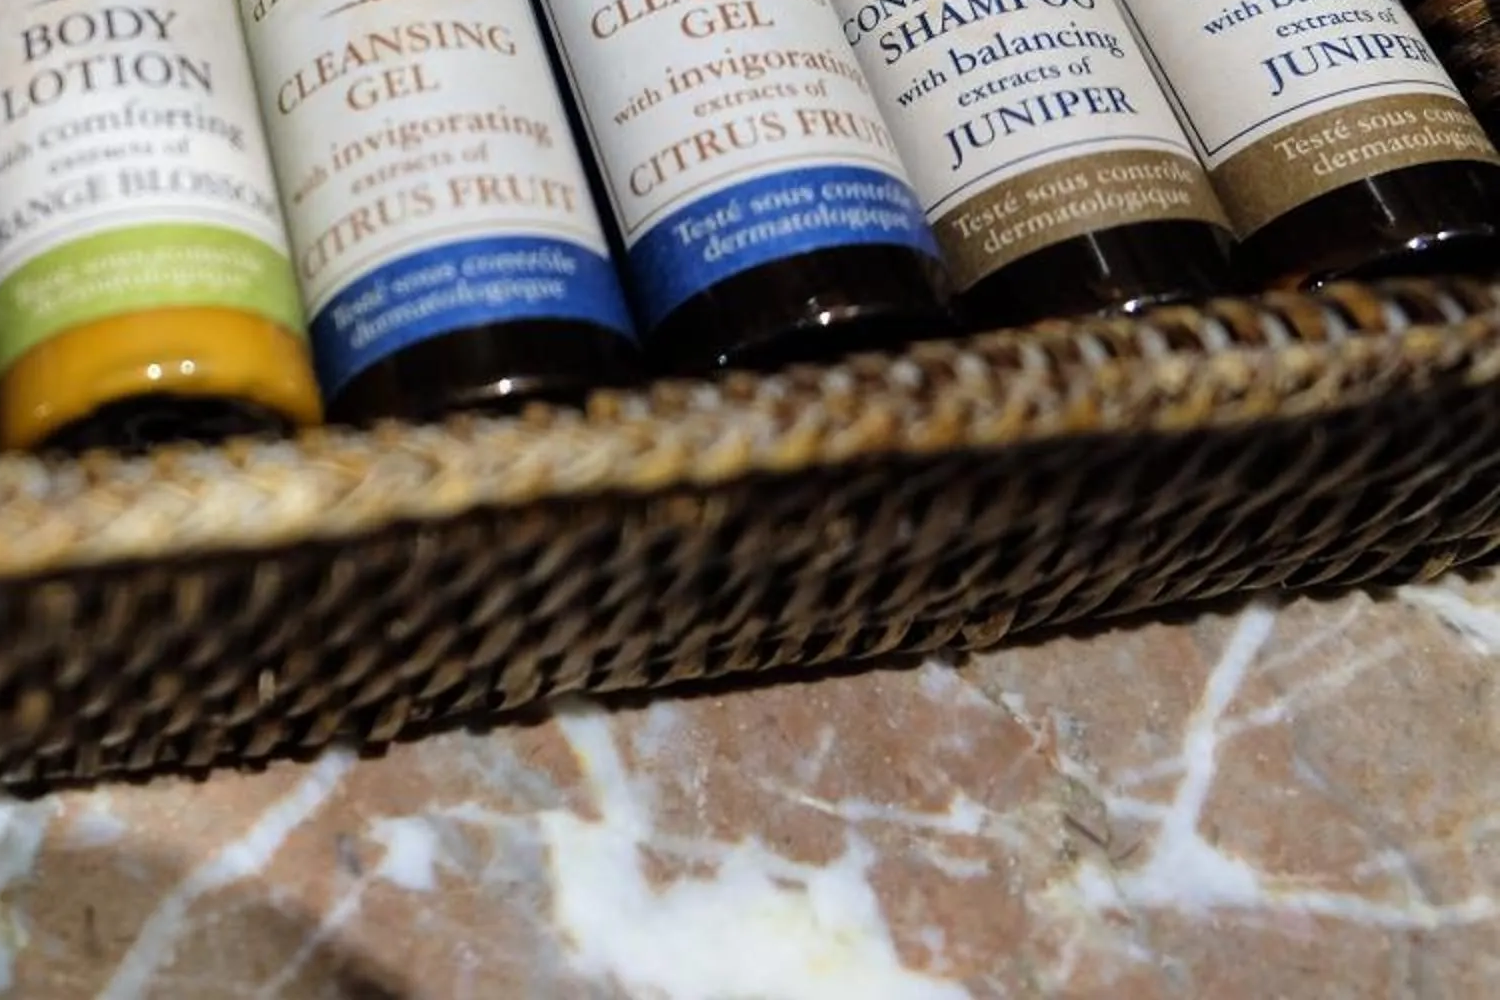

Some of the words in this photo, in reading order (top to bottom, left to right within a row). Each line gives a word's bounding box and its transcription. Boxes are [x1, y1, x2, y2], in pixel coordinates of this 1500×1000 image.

[21, 6, 178, 63] BODY
[679, 0, 776, 40] GEL
[1203, 0, 1262, 37] with
[1275, 9, 1375, 40] extracts
[1377, 7, 1398, 25] of
[0, 51, 215, 123] LOTION
[276, 20, 518, 115] CLEANSING
[344, 63, 442, 113] GEL
[894, 69, 949, 108] with
[947, 21, 1126, 78] balancing
[957, 61, 1062, 109] extracts
[1067, 56, 1094, 78] of
[1260, 32, 1438, 97] JUNIPER
[37, 96, 245, 150] comforting
[612, 86, 662, 127] with
[692, 82, 800, 118] extracts
[804, 78, 828, 98] of
[942, 85, 1139, 172] JUNIPER
[330, 104, 554, 173] invigorating
[629, 108, 787, 199] CITRUS
[1272, 119, 1352, 163] Testé
[1356, 109, 1418, 134] sous
[300, 183, 437, 280] CITRUS
[950, 193, 1022, 241] Testé
[1025, 171, 1090, 203] sous
[981, 186, 1193, 256] dermatologique
